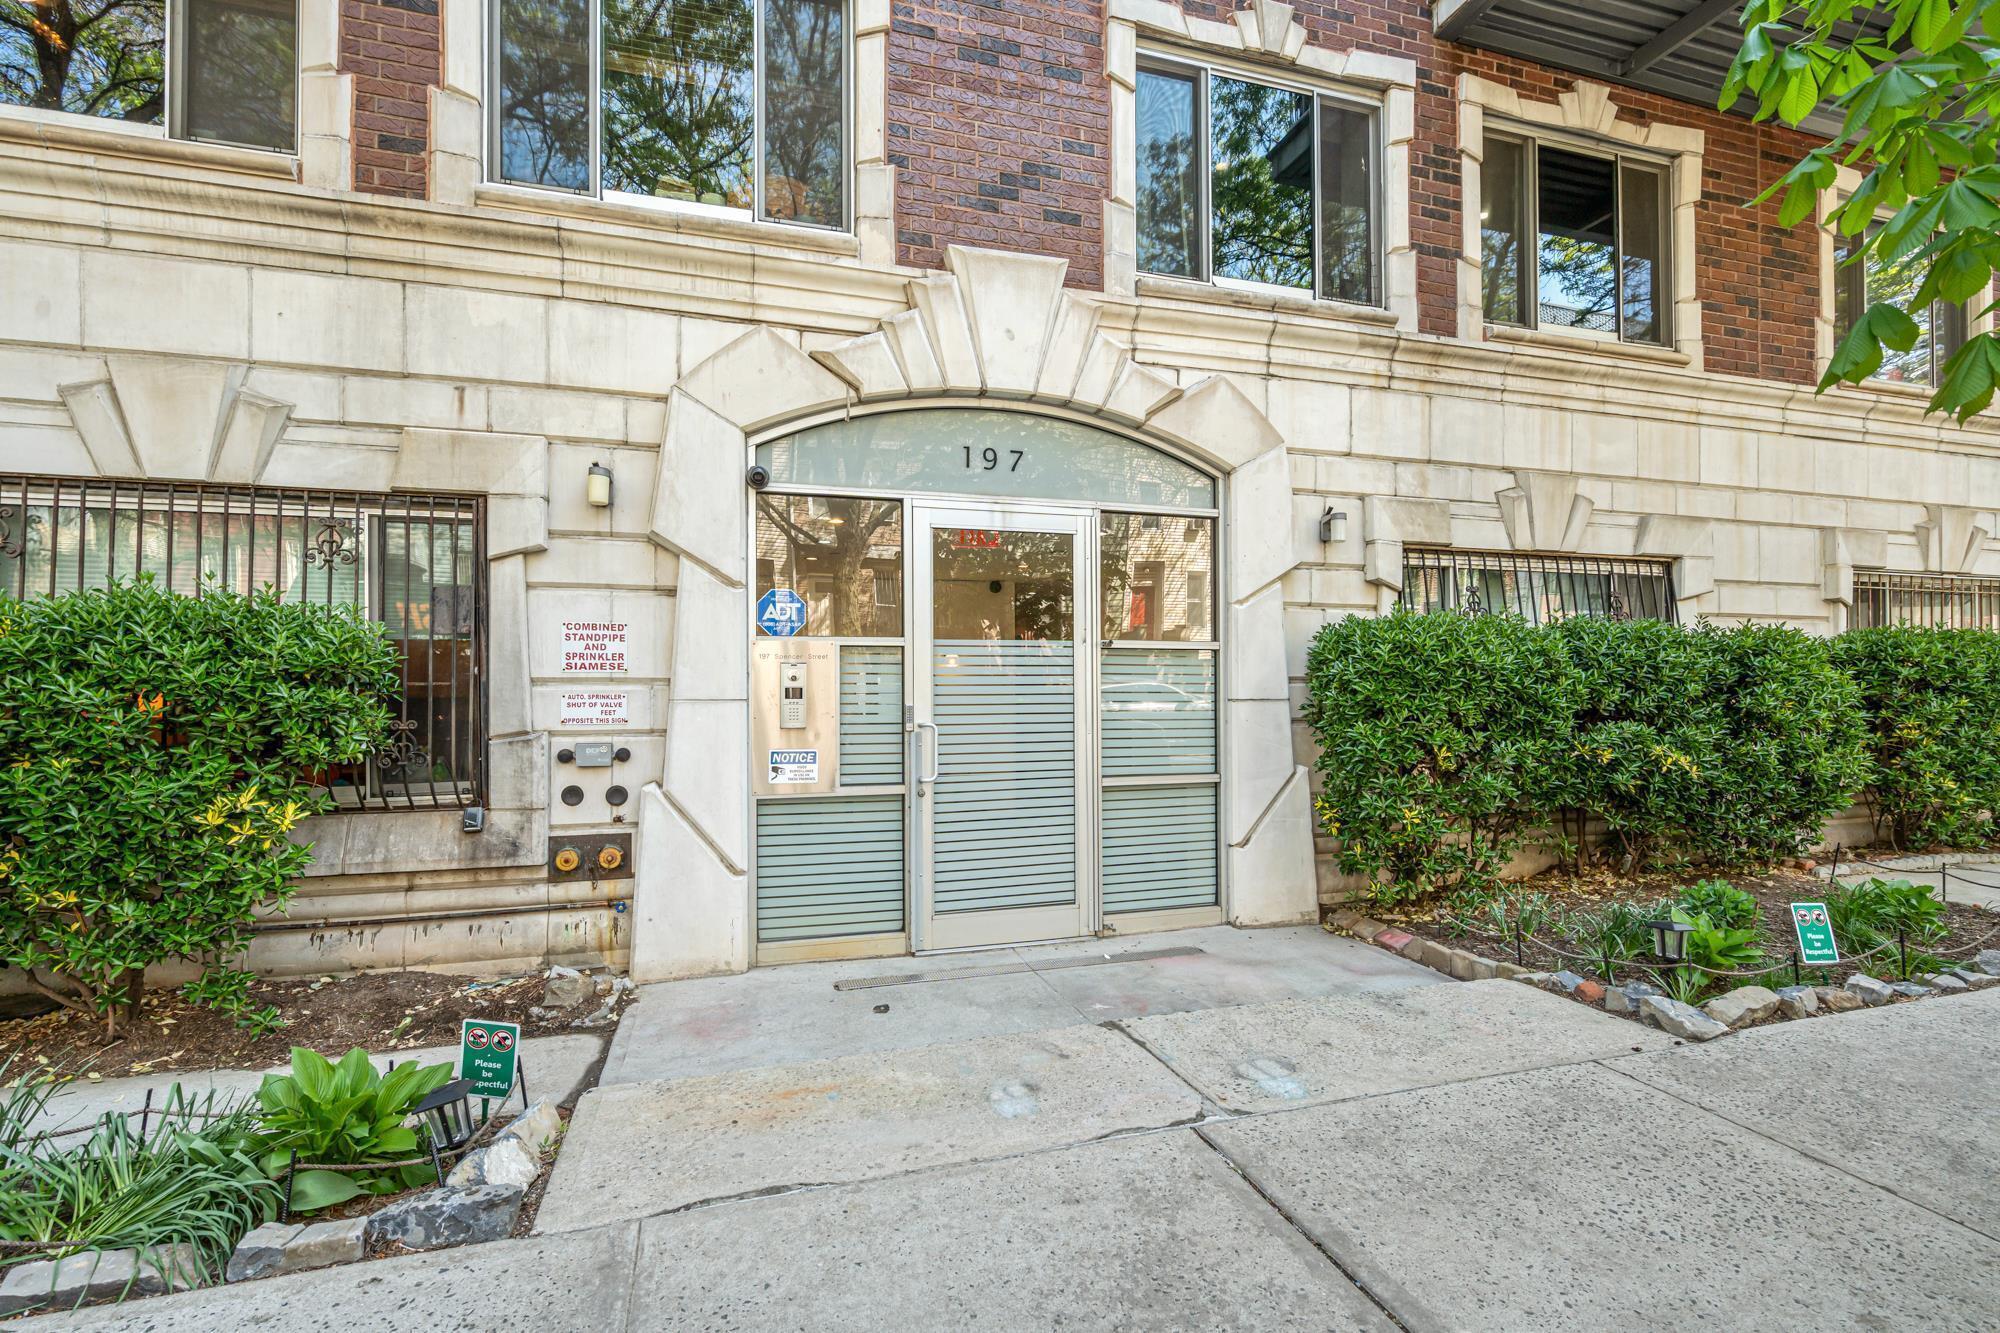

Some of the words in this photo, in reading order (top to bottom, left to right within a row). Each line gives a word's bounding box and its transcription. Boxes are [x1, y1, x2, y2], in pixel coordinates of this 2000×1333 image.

[962, 446, 1024, 472] 197
[762, 602, 801, 621] ADT
[566, 622, 625, 632] COMBINED
[564, 632, 626, 642] STANDPIPE
[584, 643, 607, 651] AND
[565, 652, 625, 661] SPRINKLER
[565, 662, 625, 671] SIAMESE
[772, 752, 816, 763] NOTICE
[1805, 948, 1834, 956] Respectful
[475, 1059, 502, 1069] Please
[475, 1081, 508, 1089] pectful
